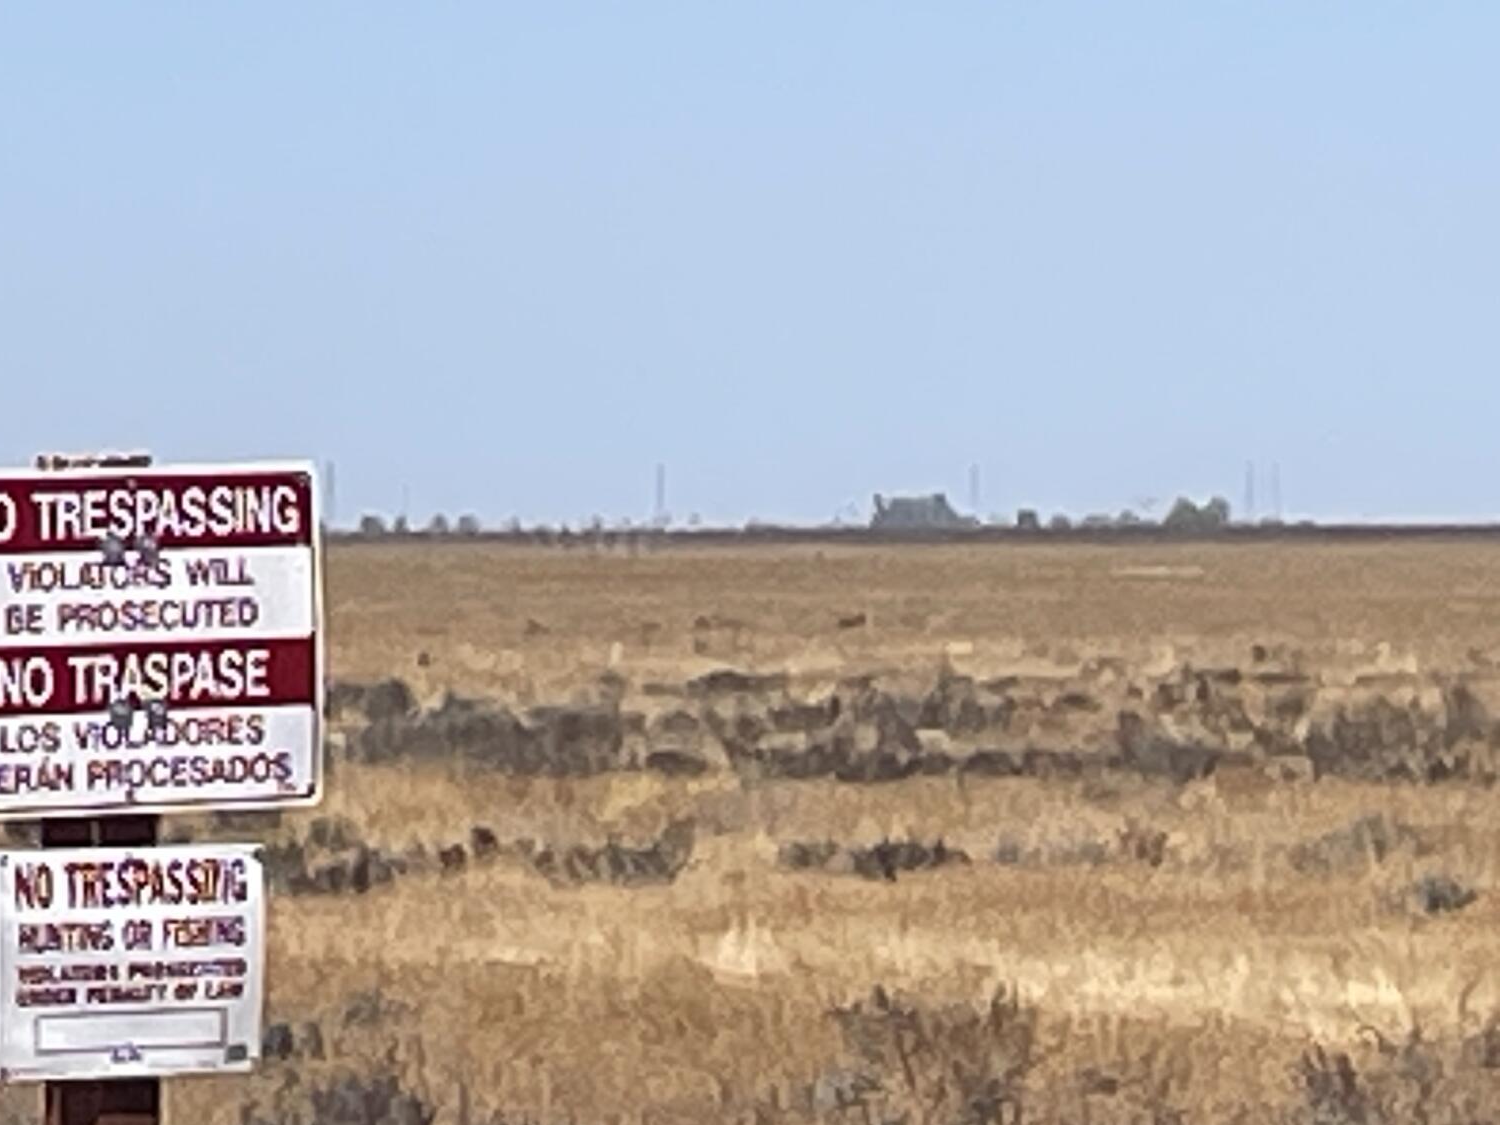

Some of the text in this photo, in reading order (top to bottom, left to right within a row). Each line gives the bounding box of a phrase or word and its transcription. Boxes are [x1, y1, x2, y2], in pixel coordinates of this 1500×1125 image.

[31, 486, 299, 541] TRESPASSING
[8, 557, 254, 593] VIOLATORS WILL
[5, 598, 258, 634] BE PROSECUTED
[67, 650, 270, 705] TRASPASE
[0, 715, 265, 754] LOS VIOLADORES
[87, 753, 293, 791] PROCESADOS
[14, 858, 247, 909] NO TRESPASSING
[122, 919, 152, 951] OR
[175, 983, 198, 1000] OF
